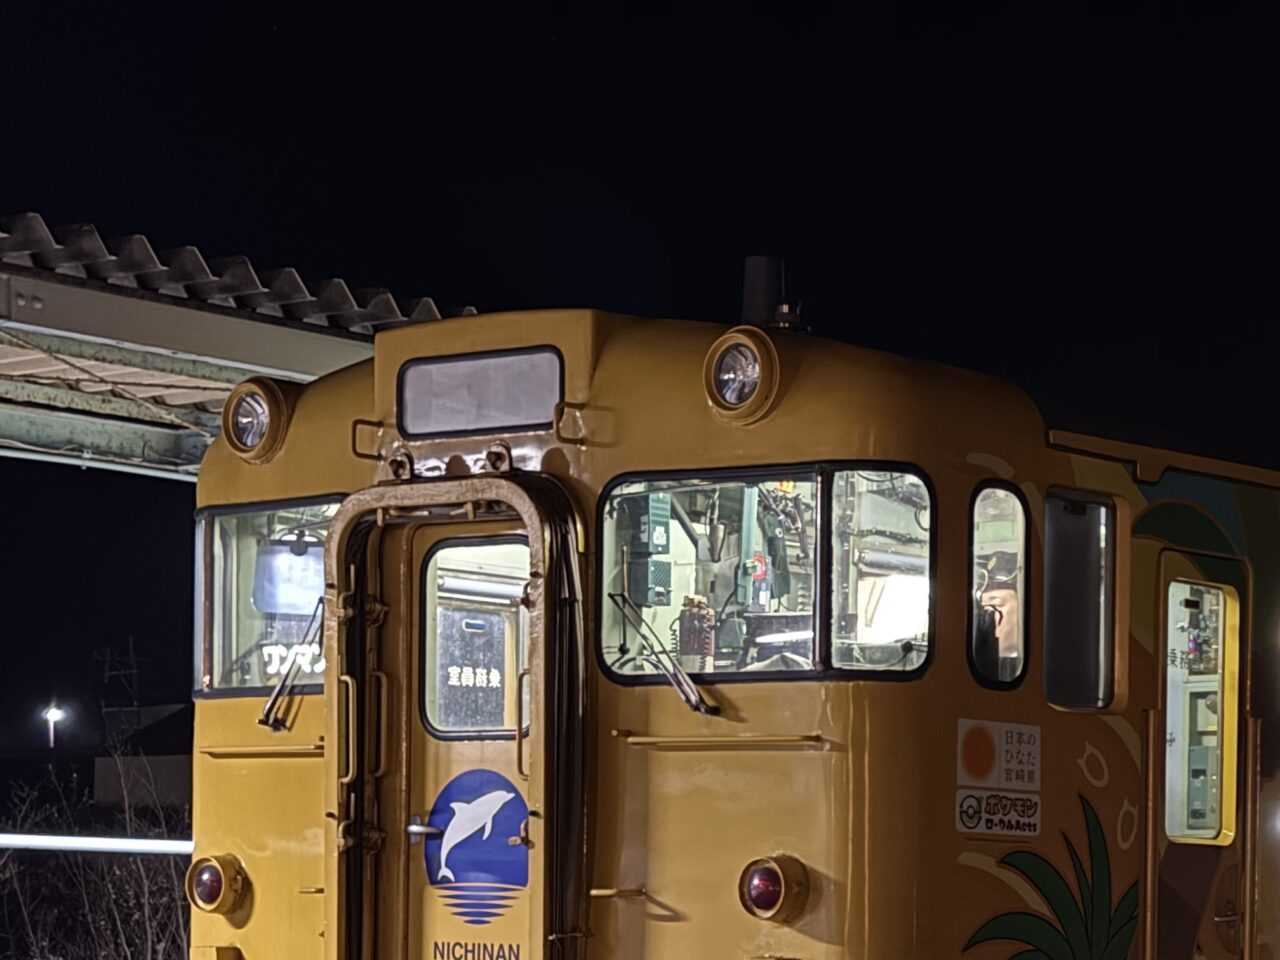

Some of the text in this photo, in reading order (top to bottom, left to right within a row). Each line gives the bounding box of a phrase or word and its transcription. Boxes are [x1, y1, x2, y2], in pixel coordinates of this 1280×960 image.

[1005, 730, 1036, 748] 日本の
[1004, 750, 1036, 767] ひなた
[984, 794, 1038, 818] ポケモン
